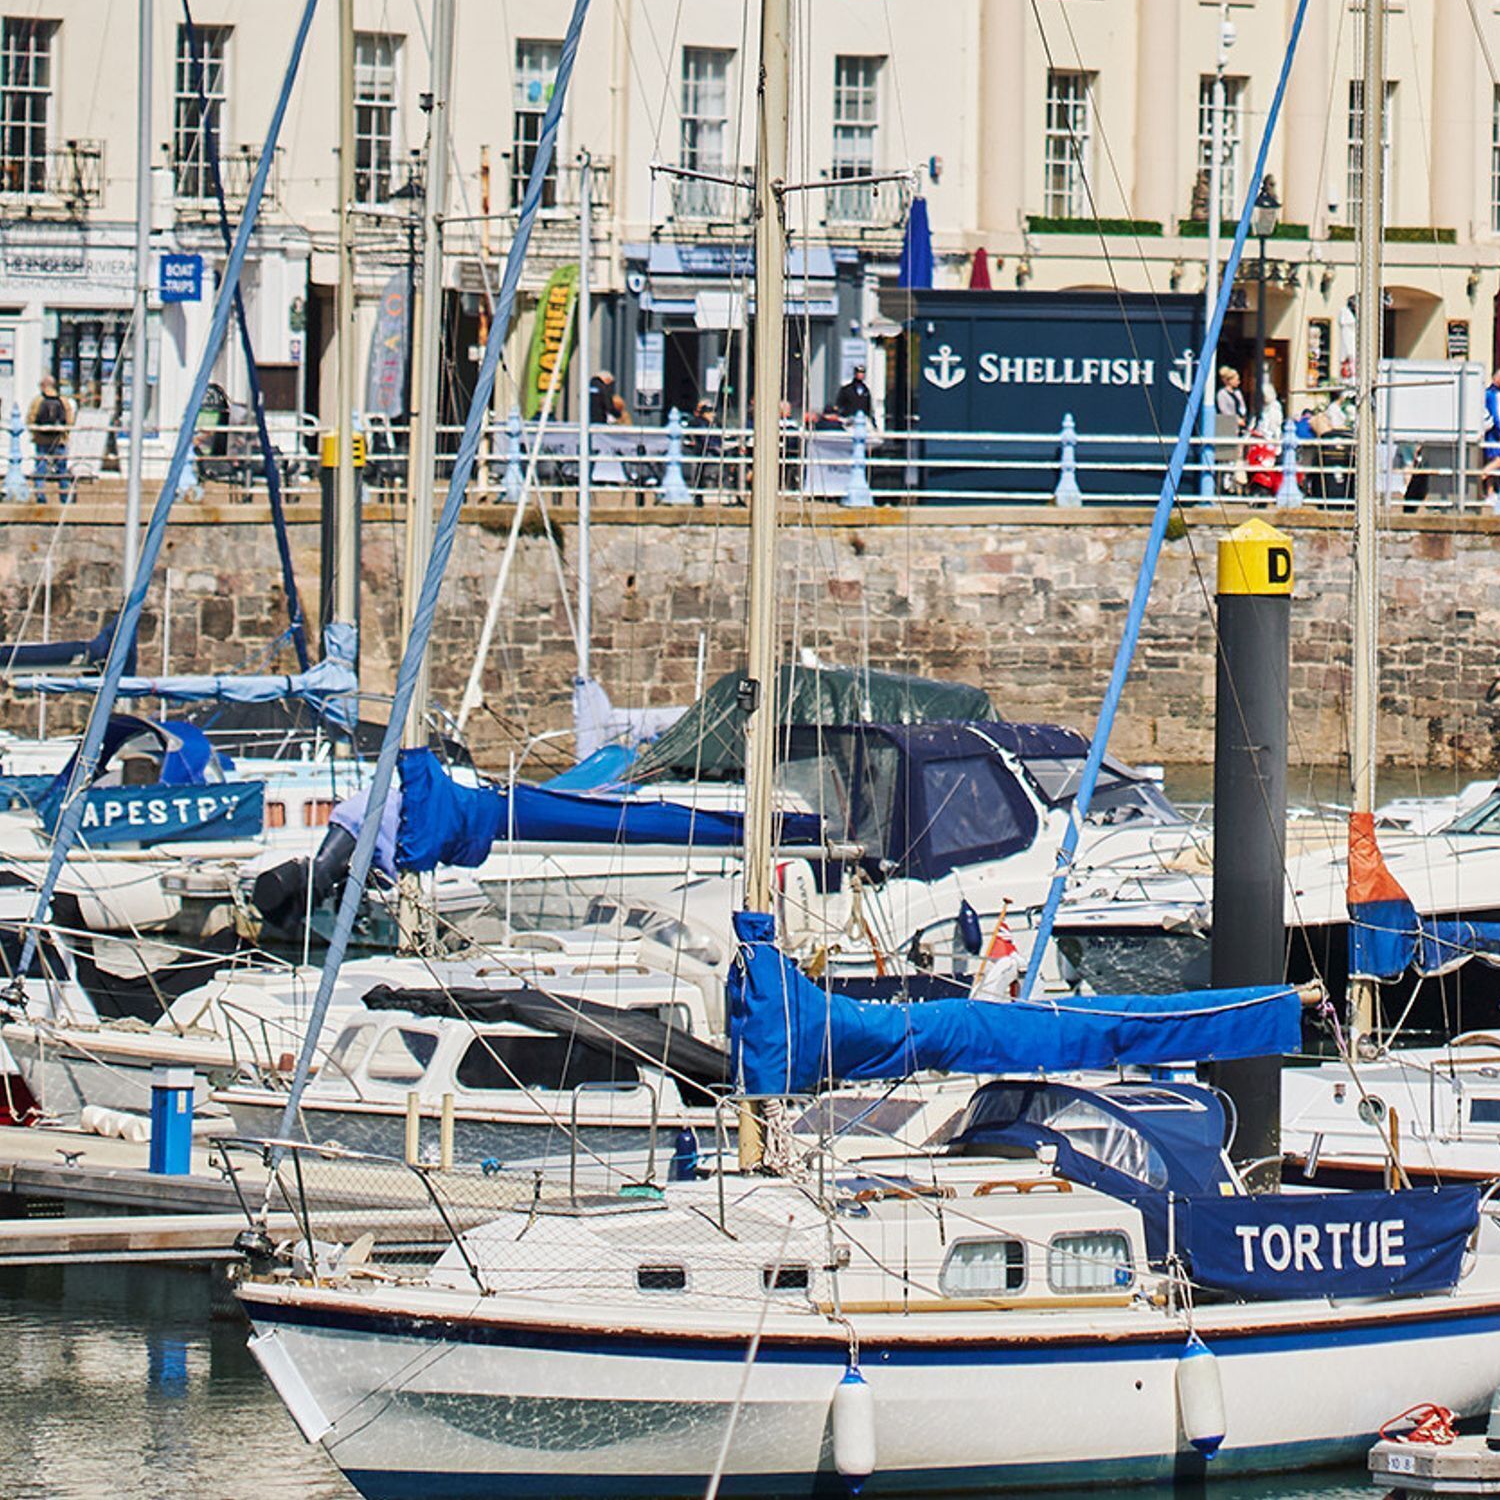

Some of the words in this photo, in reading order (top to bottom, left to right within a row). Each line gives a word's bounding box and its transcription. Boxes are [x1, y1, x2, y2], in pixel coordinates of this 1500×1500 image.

[165, 263, 195, 277] BOAT
[165, 279, 196, 294] TRIPS
[978, 352, 1155, 384] SHELLFISH
[1268, 547, 1291, 584] D
[81, 795, 241, 827] APESTRY
[1235, 1220, 1406, 1272] TORTUE
